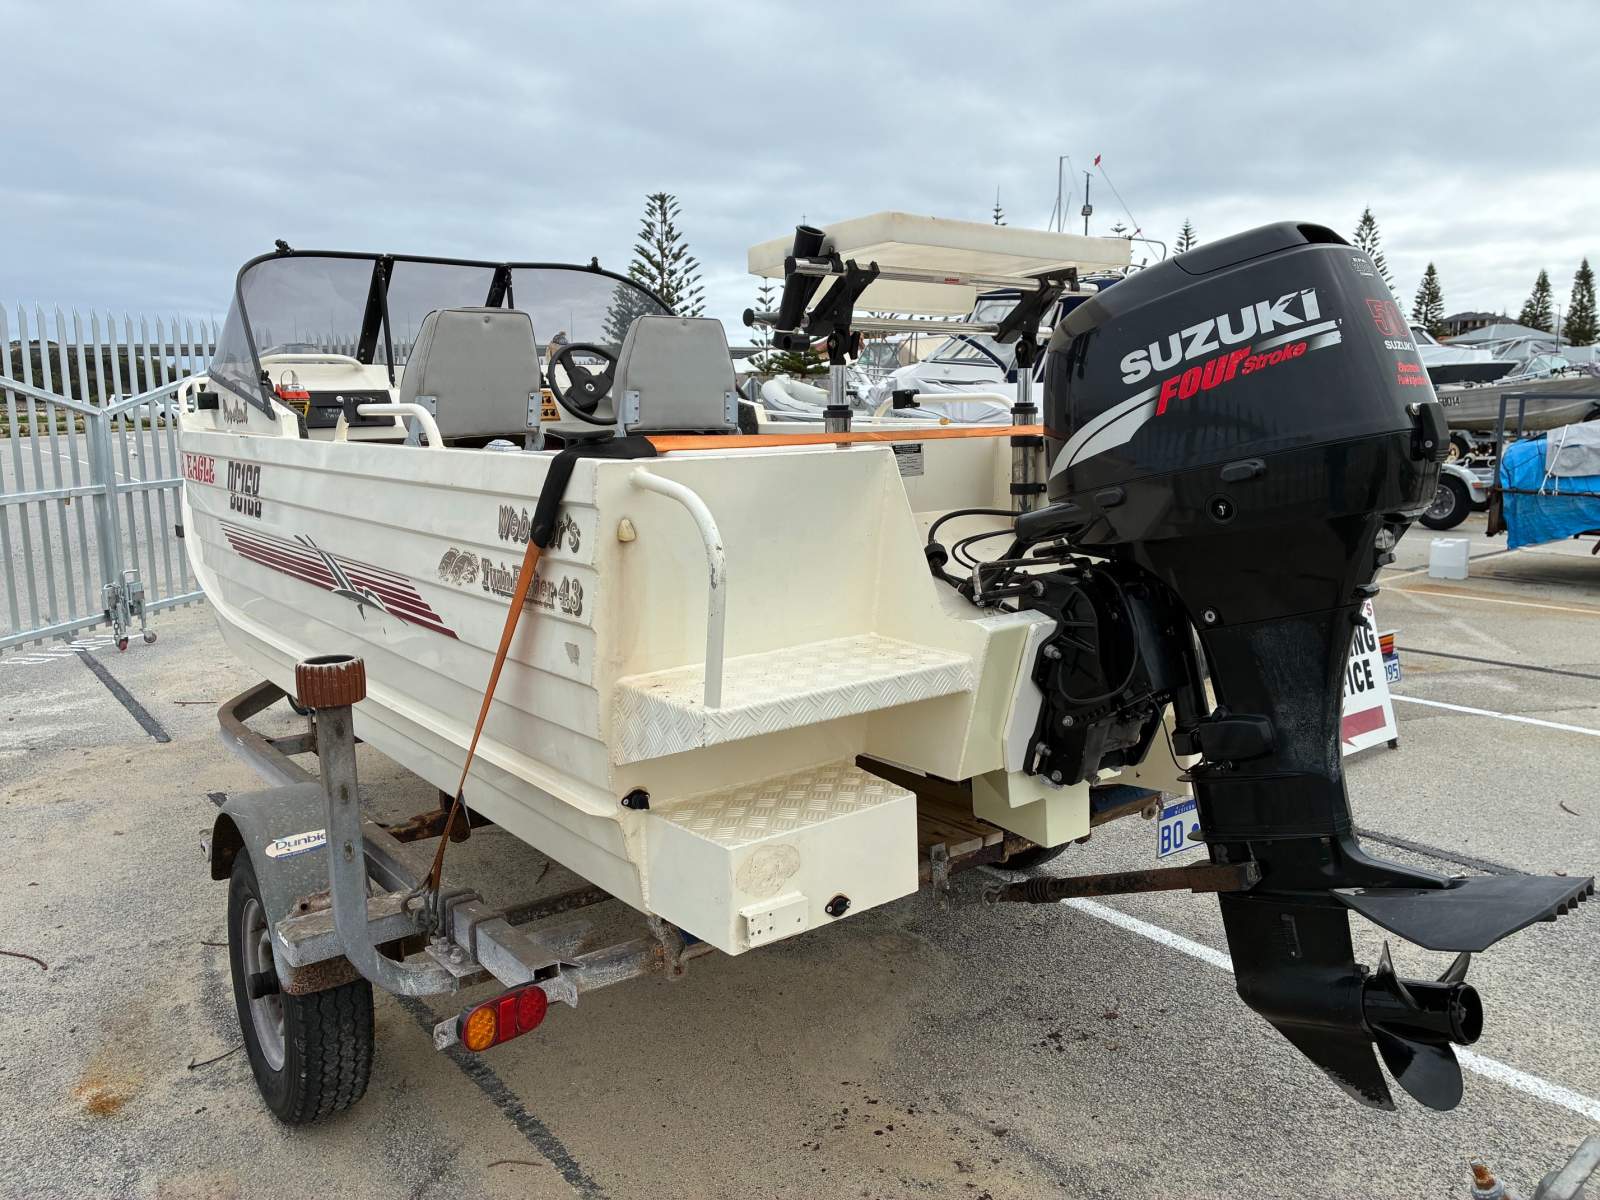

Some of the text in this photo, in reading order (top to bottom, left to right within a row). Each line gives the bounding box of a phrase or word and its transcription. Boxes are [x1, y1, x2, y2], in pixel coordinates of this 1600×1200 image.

[1120, 287, 1321, 385] SUZUKI
[1366, 299, 1409, 337] 50
[1241, 341, 1308, 376] Stroke
[1384, 340, 1415, 352] SUZUKI
[186, 454, 215, 485] EAGLE
[498, 504, 581, 554] Webr's
[1344, 659, 1375, 697] ICE
